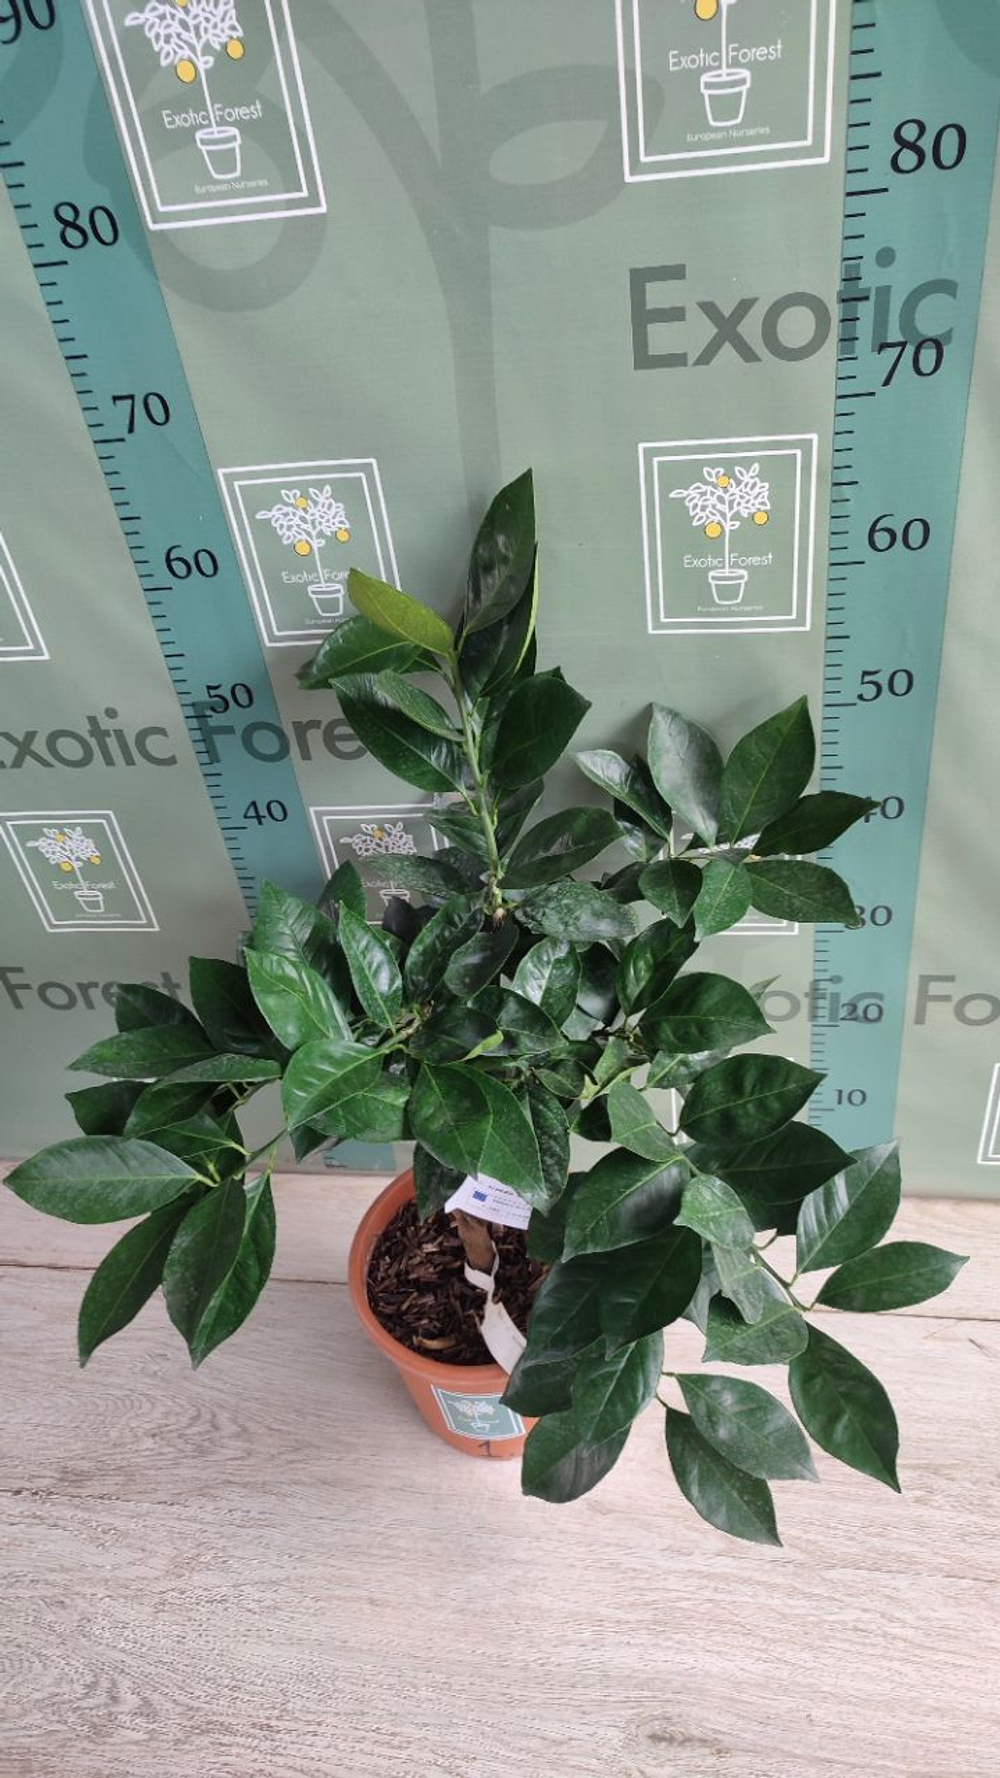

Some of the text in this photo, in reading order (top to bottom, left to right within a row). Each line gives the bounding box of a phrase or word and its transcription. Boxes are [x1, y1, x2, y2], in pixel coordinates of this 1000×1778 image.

[669, 38, 782, 71] Exotic Forest
[161, 99, 263, 129] Exotic Forest
[890, 118, 967, 174] 80
[53, 201, 119, 249] 80
[629, 246, 958, 371] Exotic
[877, 338, 944, 387] 70
[112, 392, 171, 434] 70
[867, 514, 931, 552] 60
[165, 545, 219, 579] 60
[281, 570, 319, 583] Exotic
[683, 552, 774, 568] Exotic Forest
[205, 683, 254, 714] 50
[856, 669, 914, 702] 50
[0, 700, 369, 769] xotic Fore
[243, 800, 288, 825] 40
[840, 1003, 883, 1022] 20
[834, 1089, 867, 1106] 10
